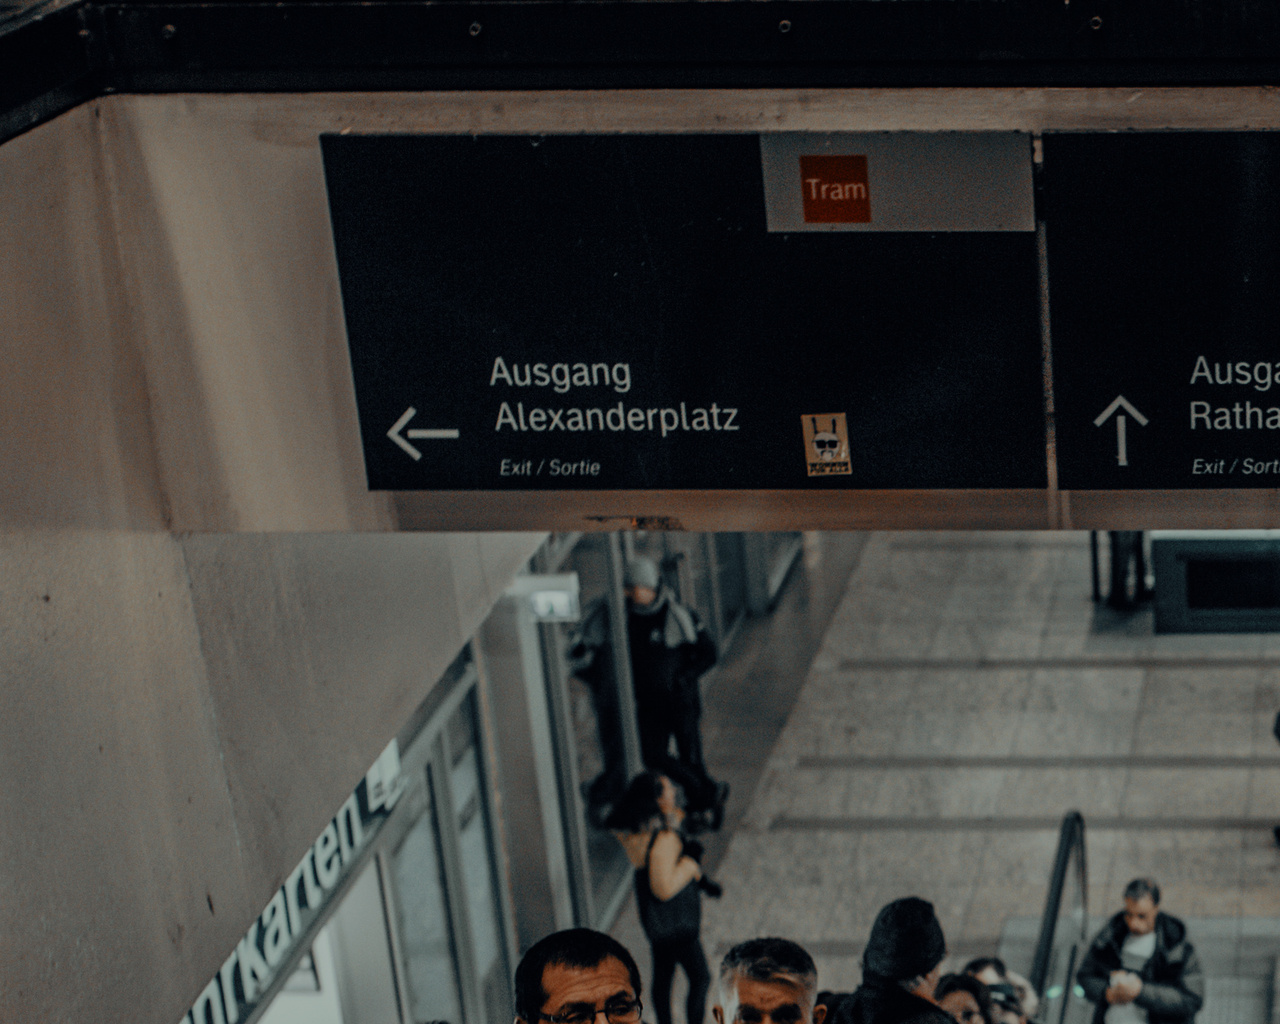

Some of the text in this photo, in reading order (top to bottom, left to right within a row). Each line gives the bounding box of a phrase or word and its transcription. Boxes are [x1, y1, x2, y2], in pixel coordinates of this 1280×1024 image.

[806, 178, 866, 201] Tram
[490, 356, 632, 393] Ausgang
[495, 401, 740, 437] Alexanderplatz
[499, 458, 601, 476] Exit / Sortie
[1192, 458, 1226, 475] Exit
[1228, 458, 1240, 475] /
